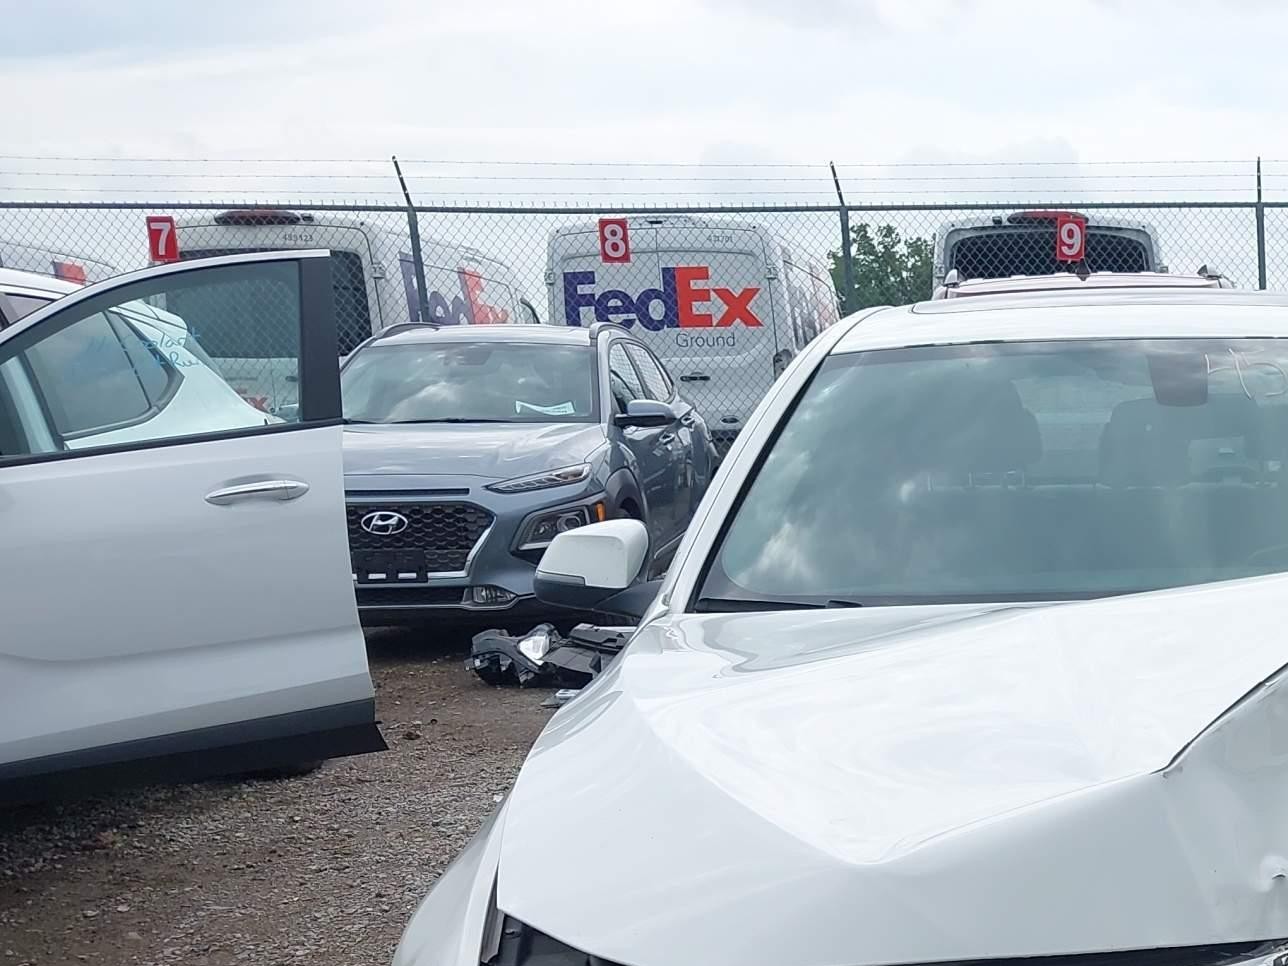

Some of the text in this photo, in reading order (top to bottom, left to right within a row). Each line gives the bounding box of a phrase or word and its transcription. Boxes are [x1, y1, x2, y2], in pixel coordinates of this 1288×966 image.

[150, 222, 171, 256] 7
[604, 224, 626, 257] 8
[1061, 223, 1081, 256] 9
[563, 266, 764, 331] FedEx
[676, 333, 736, 348] Ground
